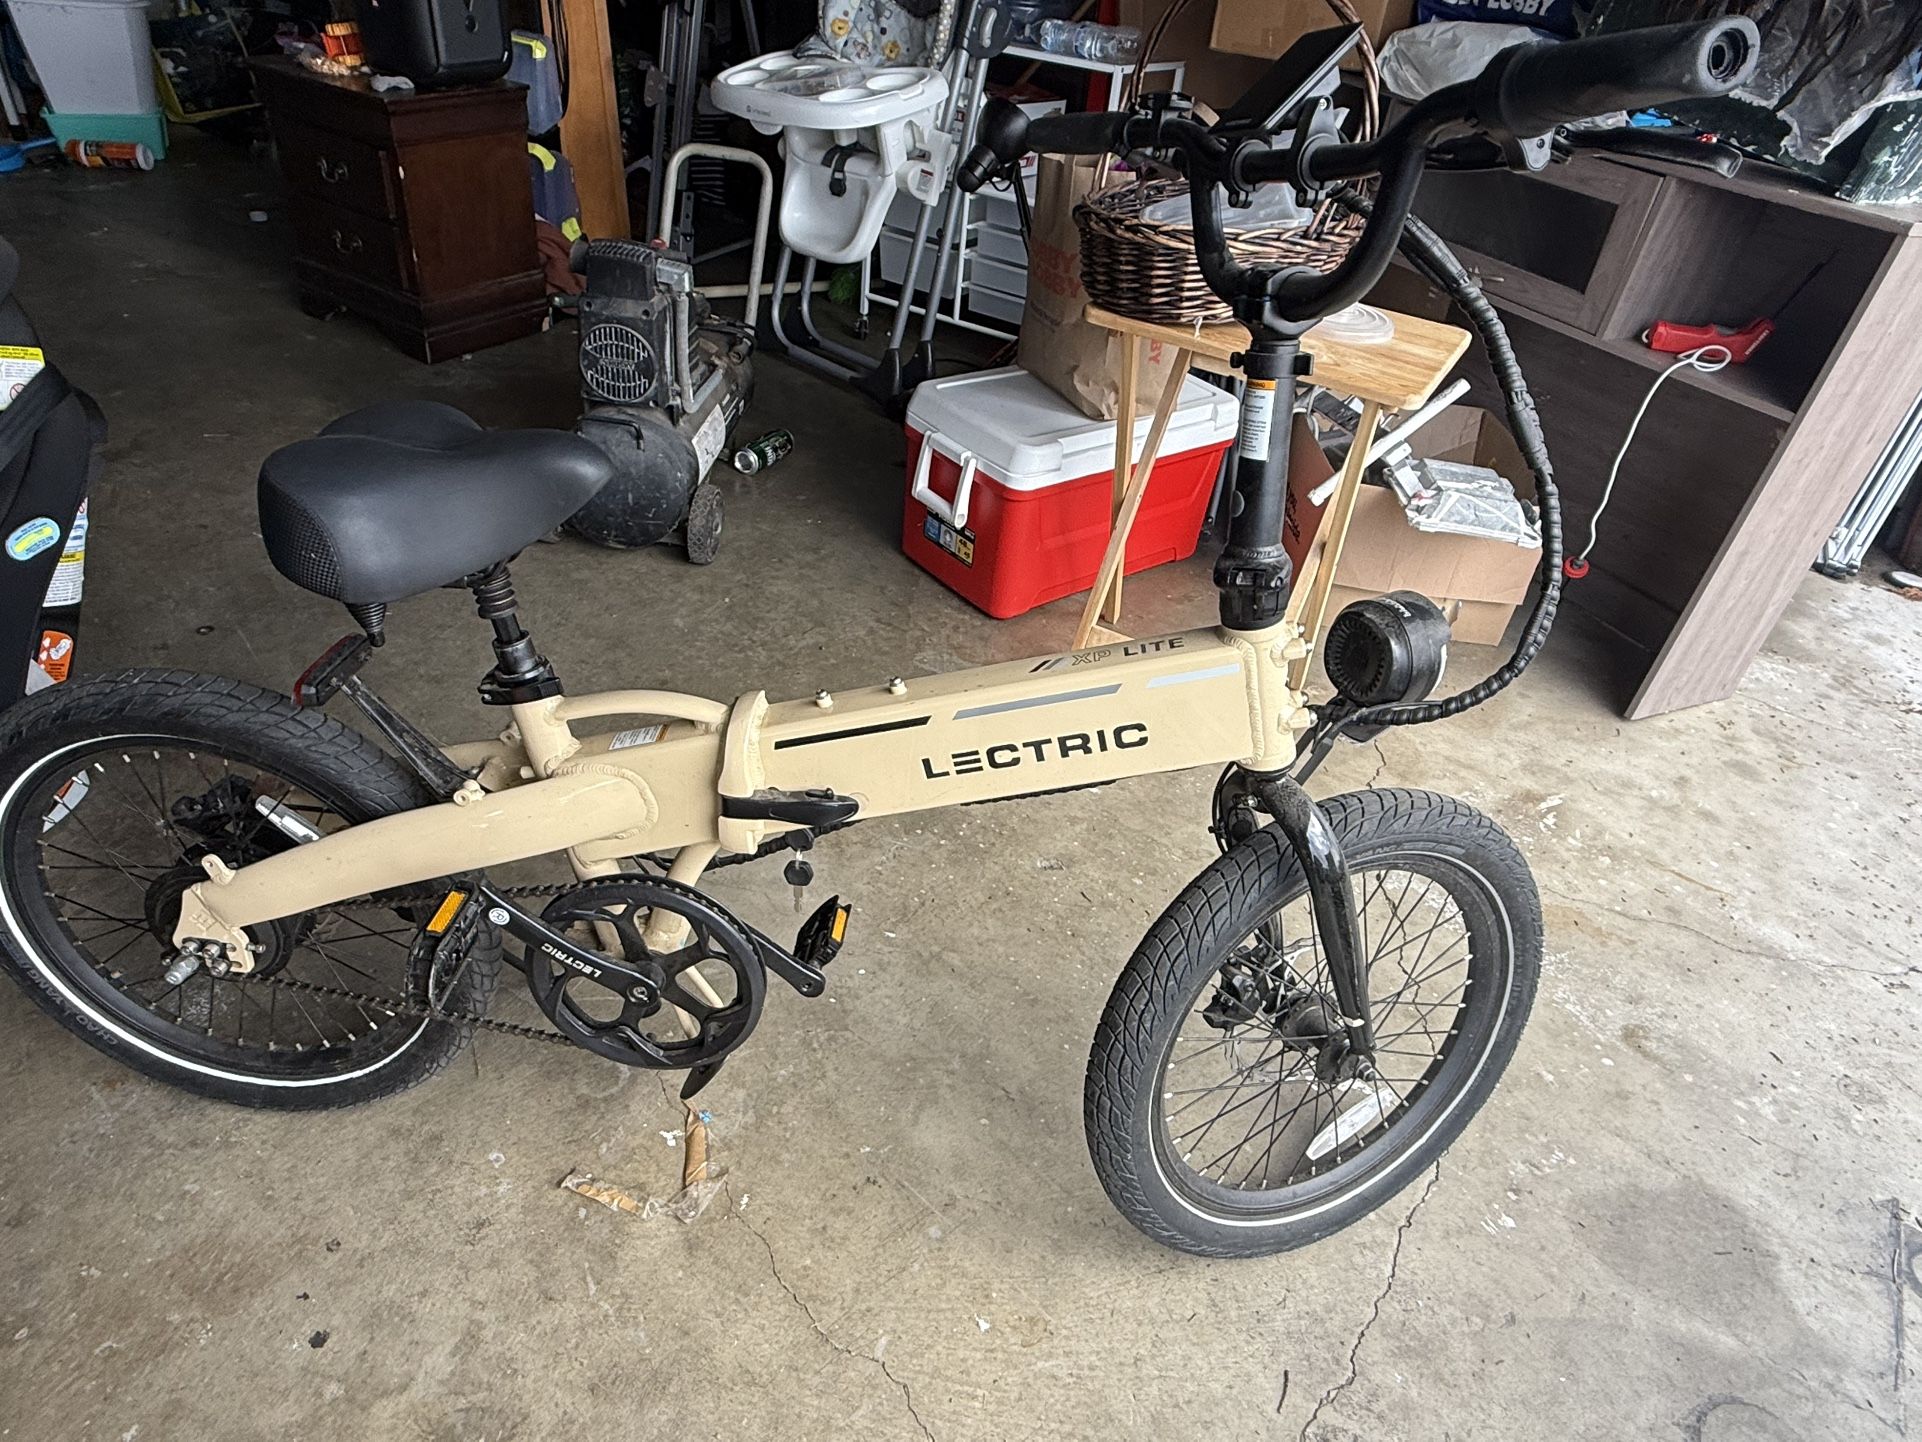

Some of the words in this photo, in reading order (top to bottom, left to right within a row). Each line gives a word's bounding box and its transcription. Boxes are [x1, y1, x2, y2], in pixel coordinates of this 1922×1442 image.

[1071, 649, 1112, 666] XP
[1123, 637, 1185, 657] LITE
[921, 722, 1149, 780] LECTRIC
[540, 942, 603, 978] LECTRIC
